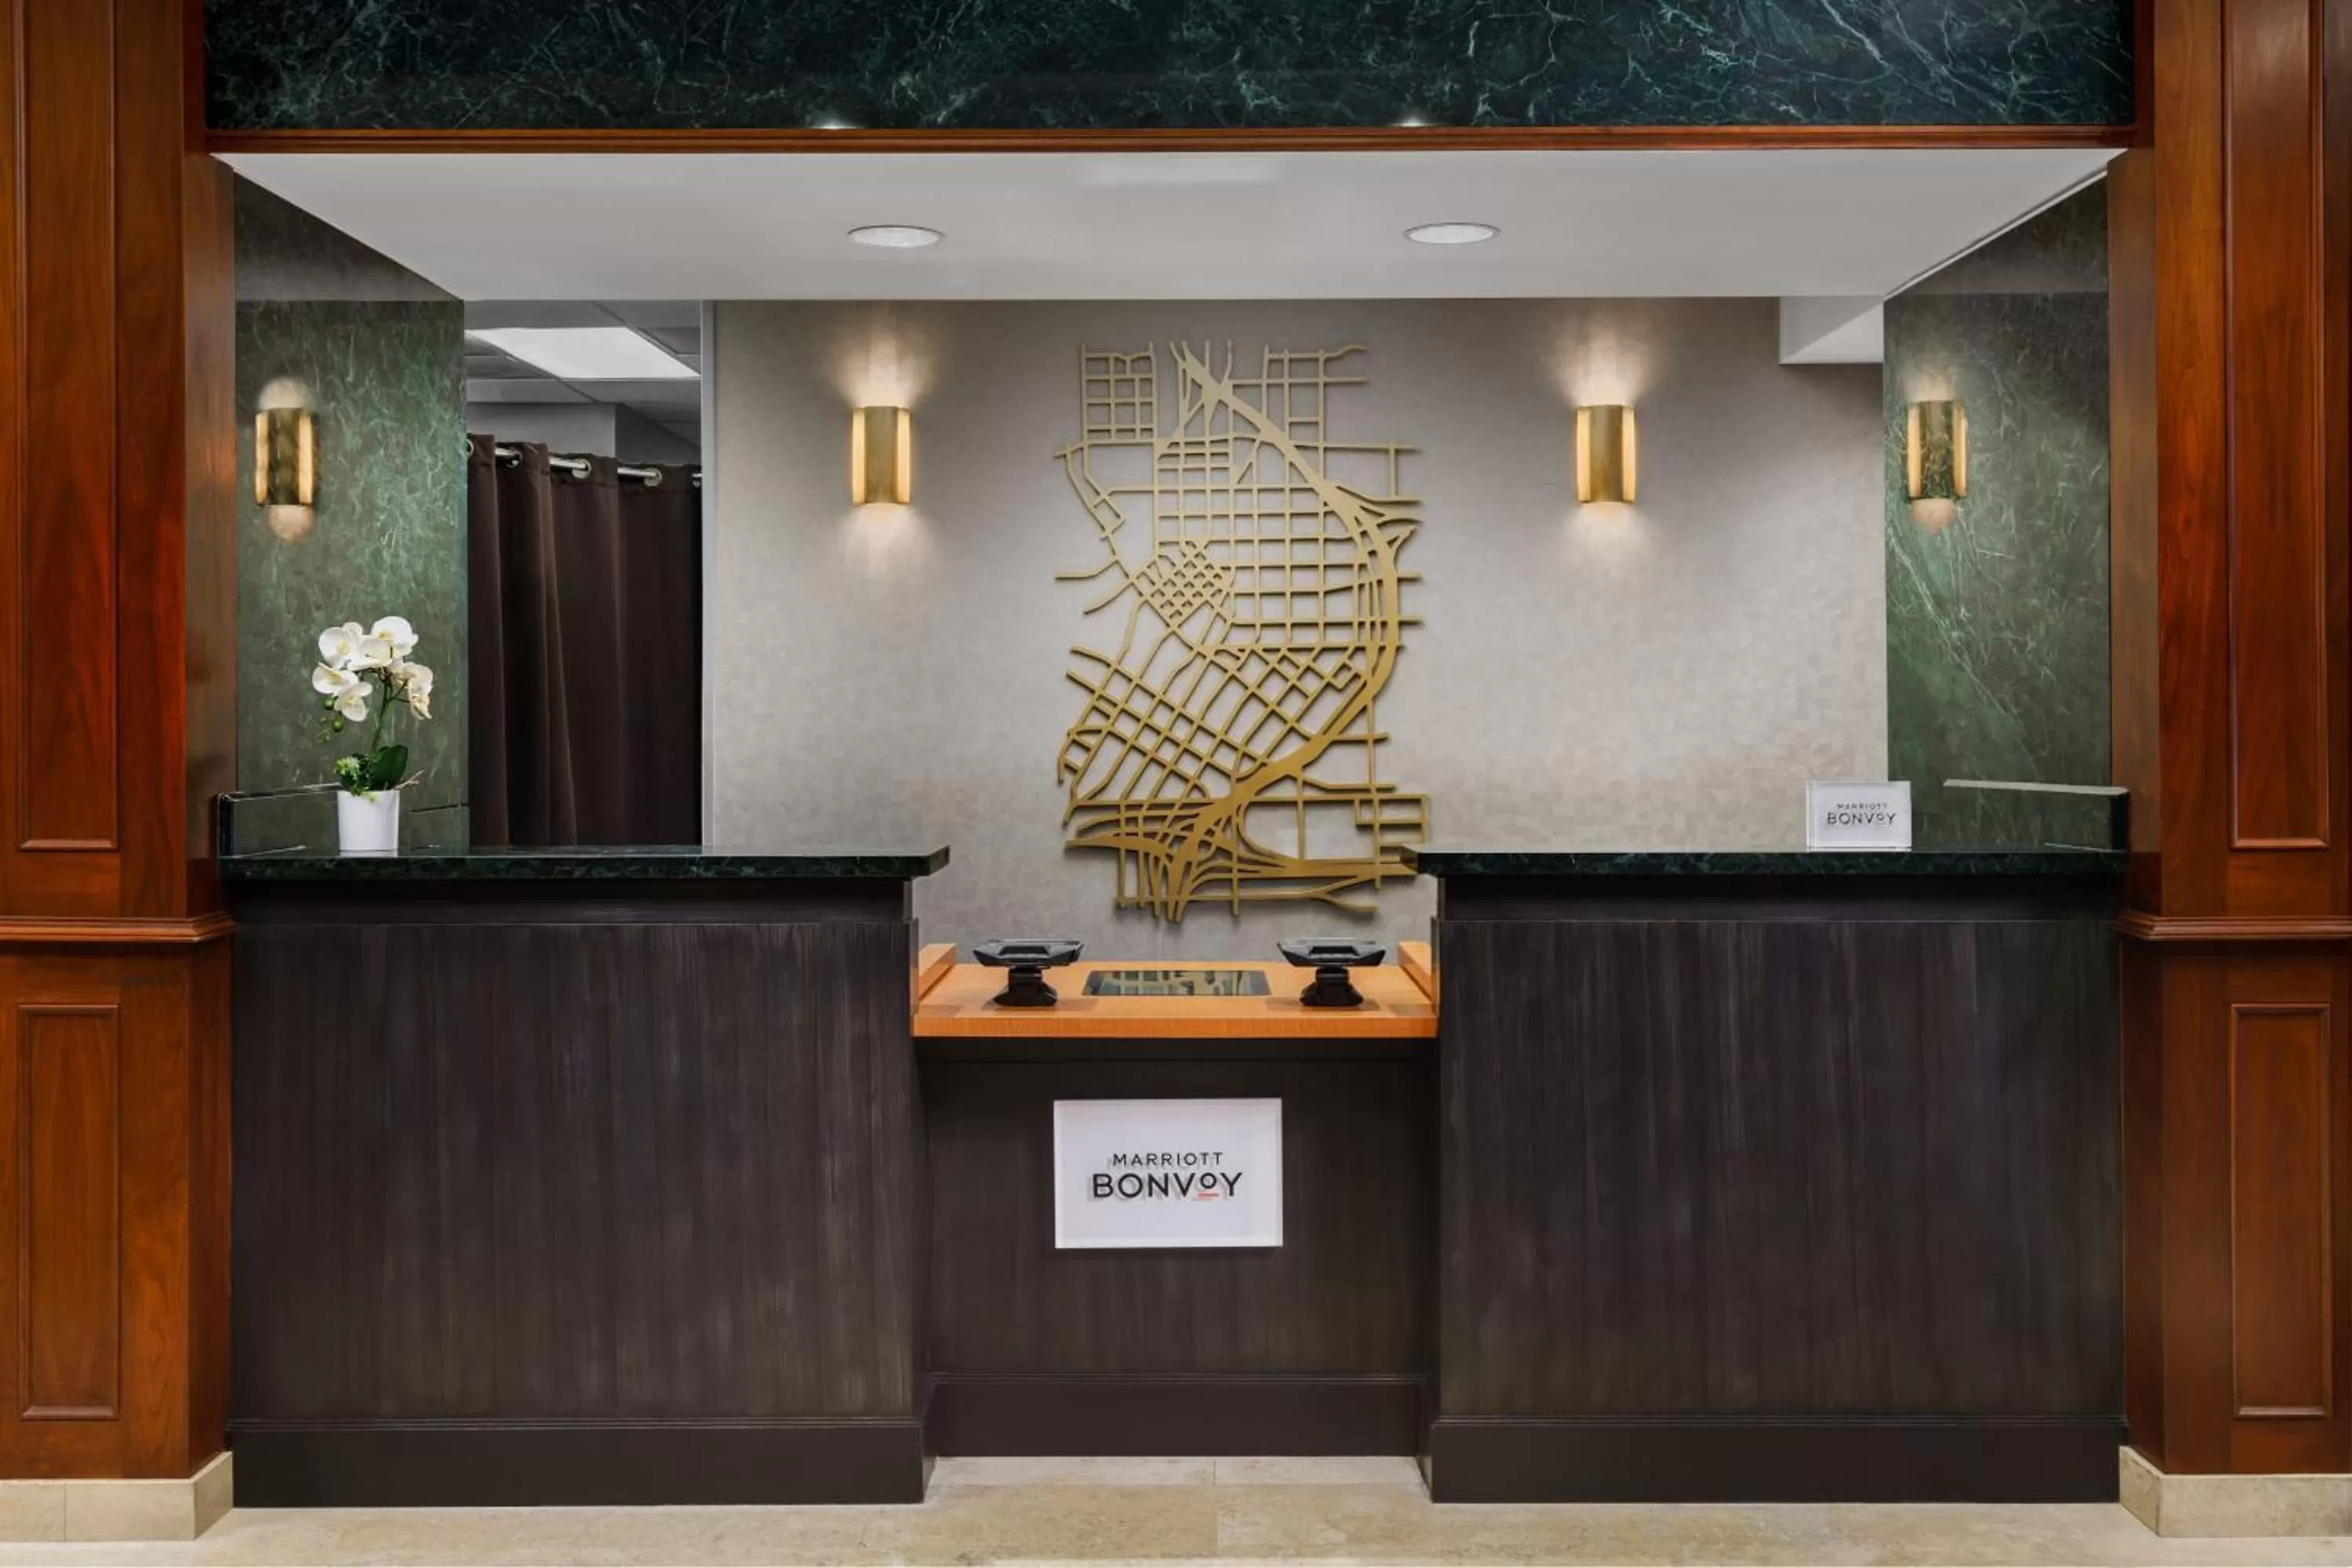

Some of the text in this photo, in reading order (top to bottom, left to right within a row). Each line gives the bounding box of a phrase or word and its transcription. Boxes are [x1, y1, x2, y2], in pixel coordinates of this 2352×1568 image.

[1826, 812, 1897, 826] BONVOY
[1112, 1152, 1223, 1167] MARRIOTT
[1091, 1171, 1243, 1199] BONVOY
